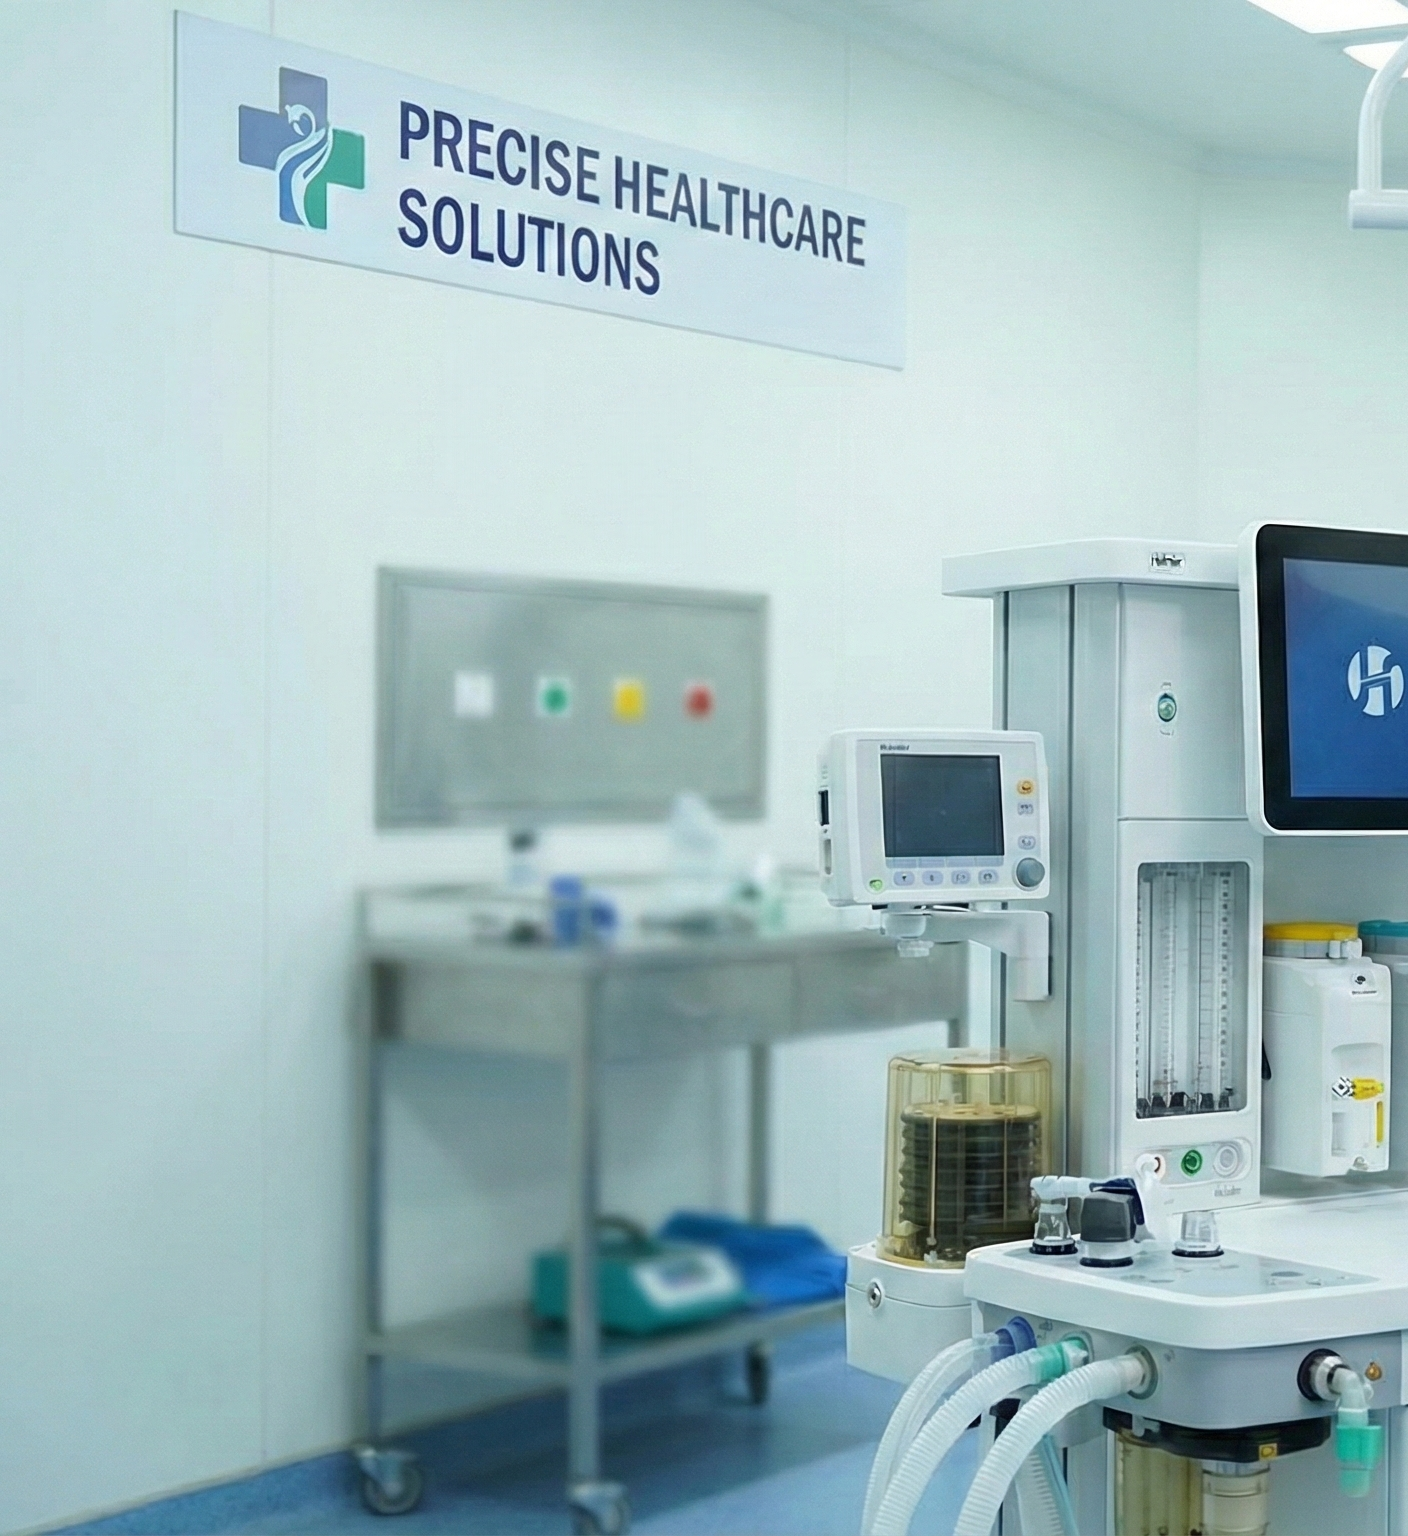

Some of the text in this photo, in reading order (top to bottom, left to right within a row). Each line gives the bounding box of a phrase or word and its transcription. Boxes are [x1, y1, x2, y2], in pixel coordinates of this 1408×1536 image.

[397, 188, 661, 296] SOLUTIONS
[400, 100, 867, 267] PRECISE HEALTHCARE
